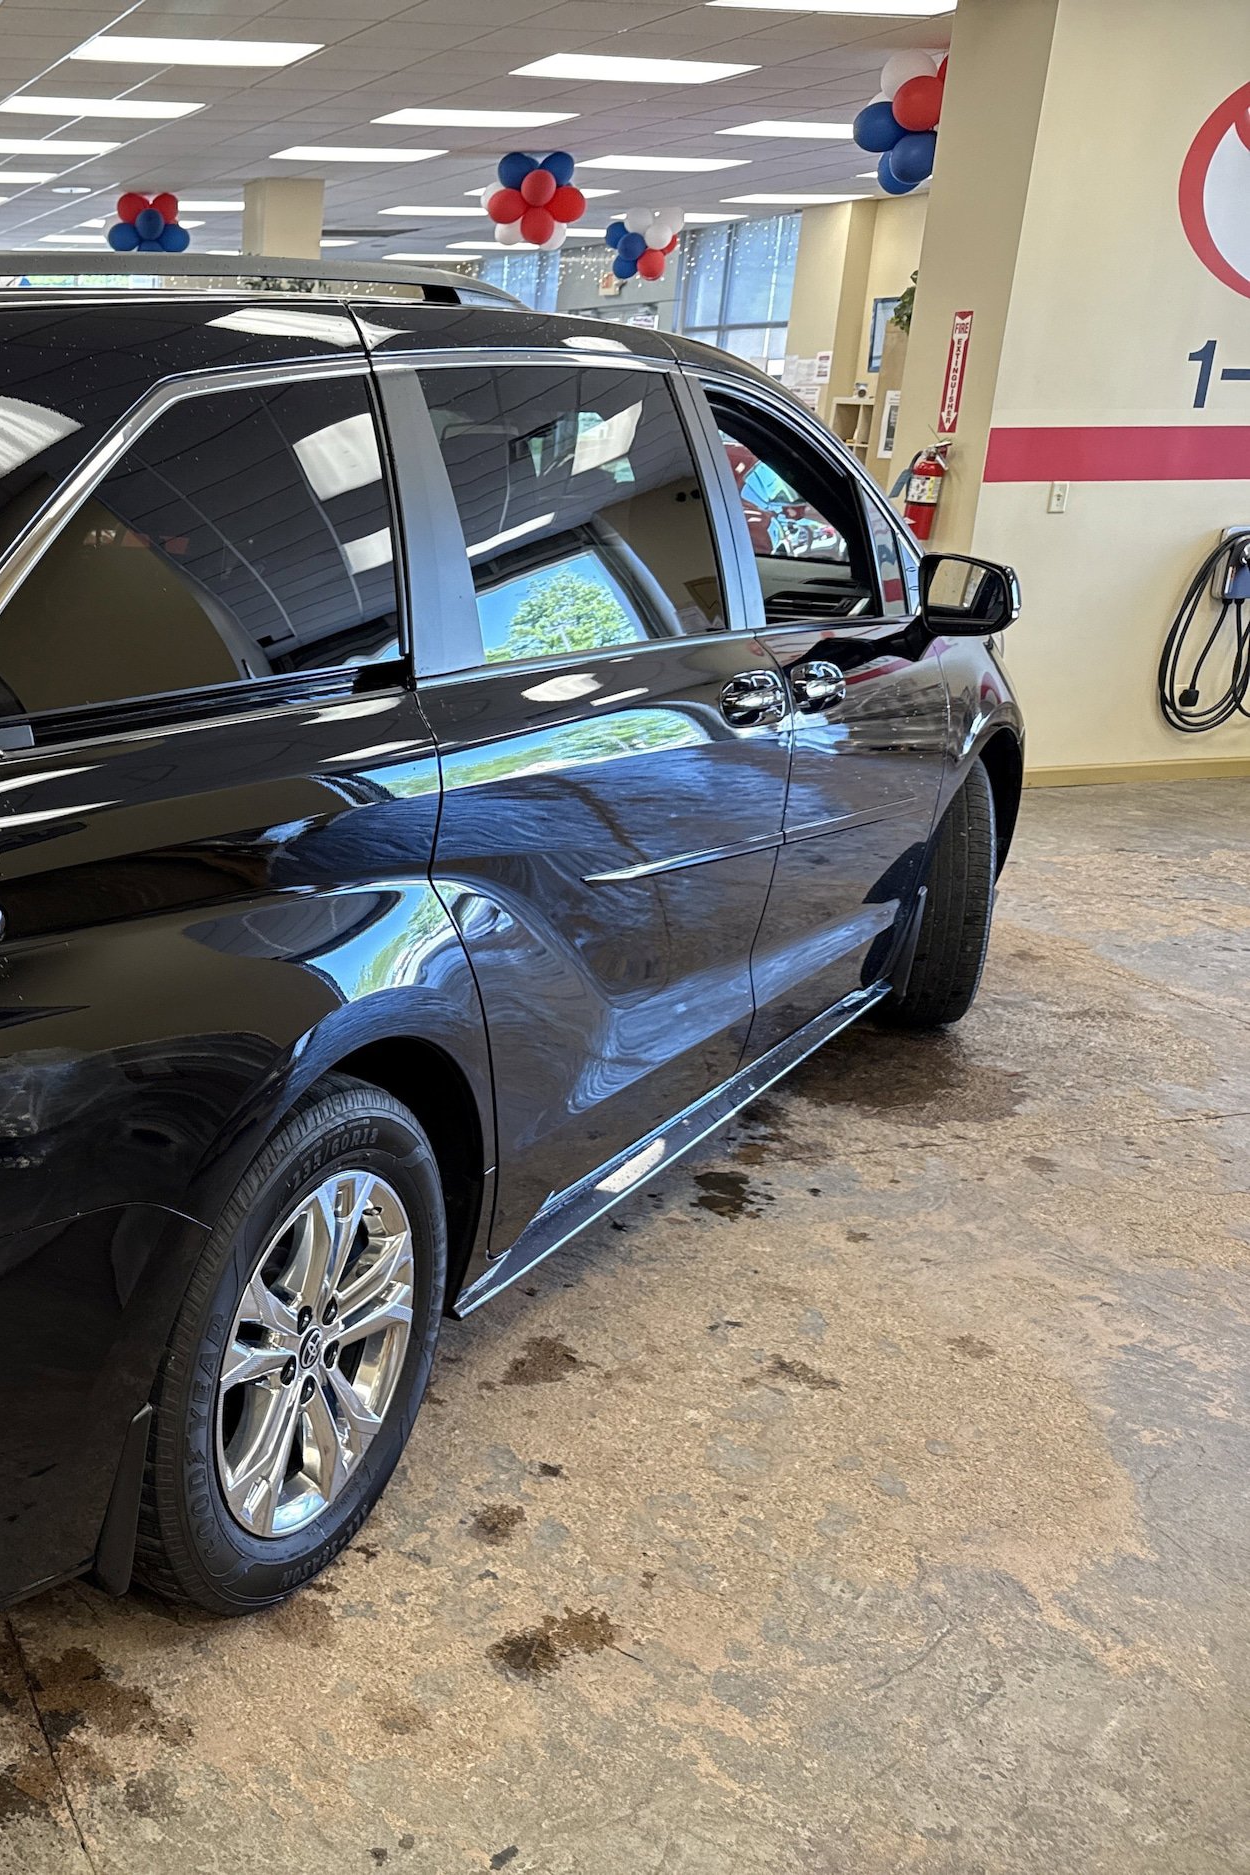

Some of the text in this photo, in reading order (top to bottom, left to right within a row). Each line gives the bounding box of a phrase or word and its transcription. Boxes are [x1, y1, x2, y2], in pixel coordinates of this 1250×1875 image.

[954, 322, 969, 335] FIRE
[945, 338, 963, 424] EXTINGUISHER
[292, 1127, 379, 1190] 235/60R18
[182, 1311, 226, 1560] GOODYEAR
